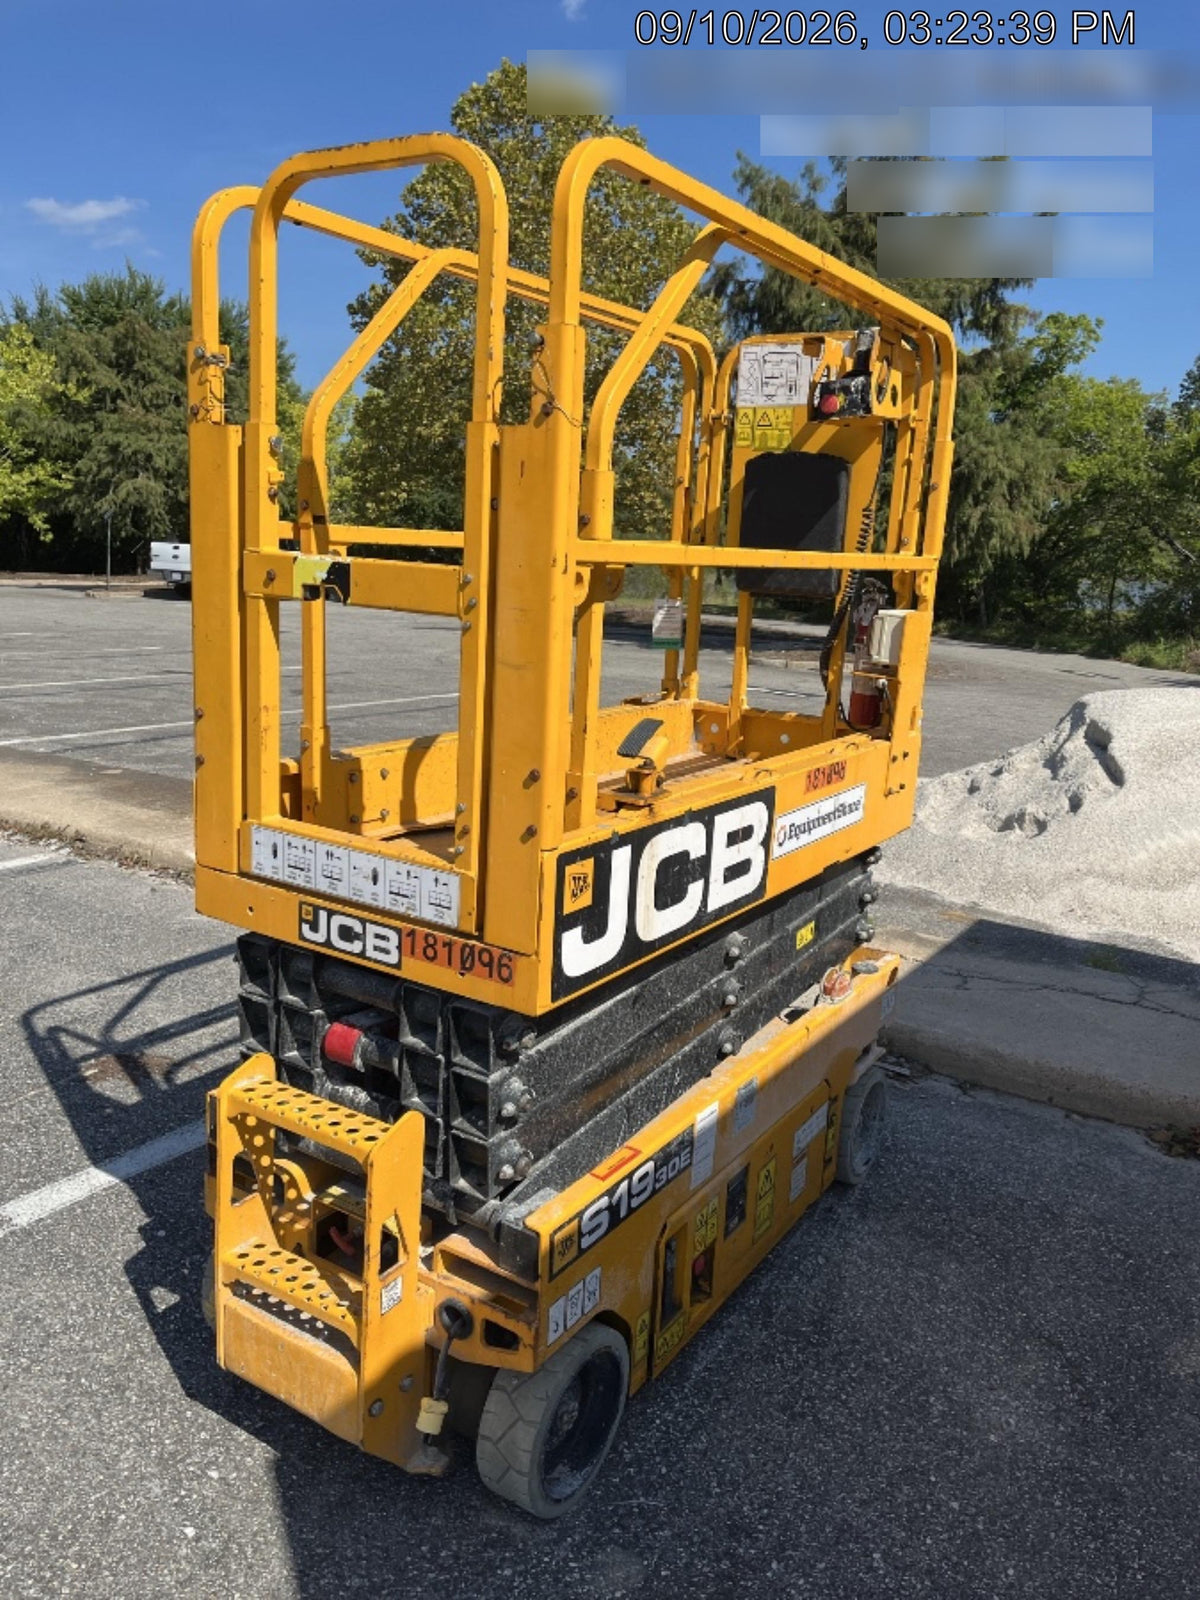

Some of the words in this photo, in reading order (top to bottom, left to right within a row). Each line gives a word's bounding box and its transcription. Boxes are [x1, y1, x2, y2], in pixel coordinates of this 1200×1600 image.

[561, 801, 769, 978] JCB
[301, 909, 400, 965] JCB
[404, 928, 514, 984] 181096
